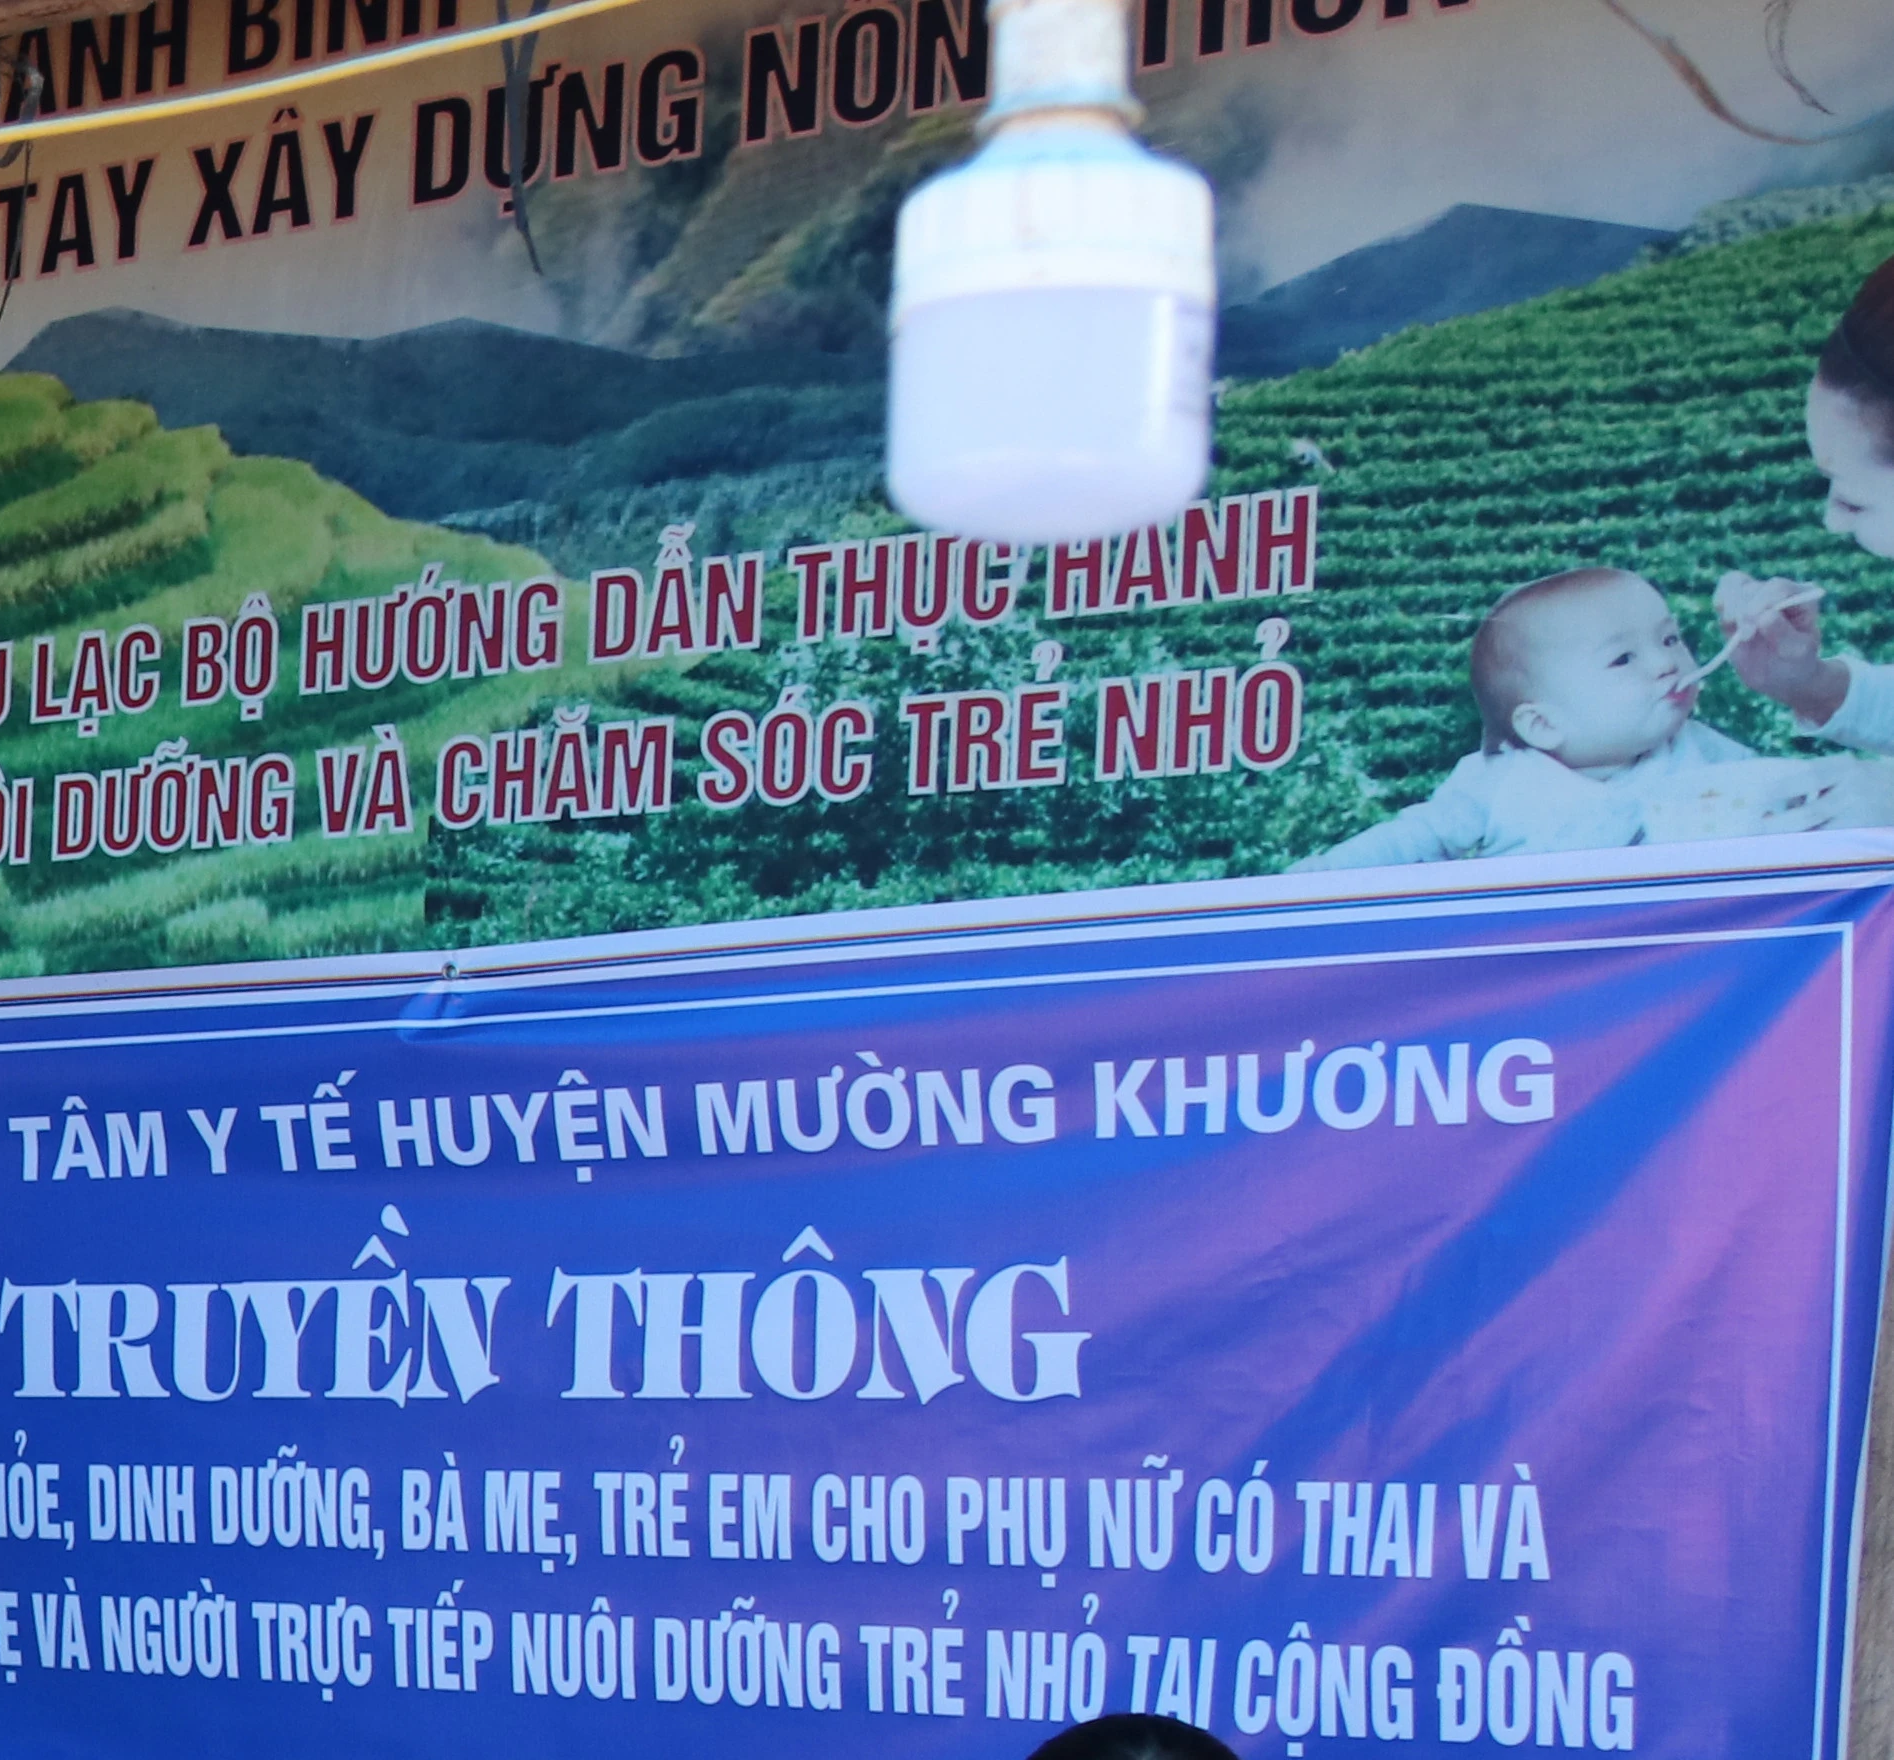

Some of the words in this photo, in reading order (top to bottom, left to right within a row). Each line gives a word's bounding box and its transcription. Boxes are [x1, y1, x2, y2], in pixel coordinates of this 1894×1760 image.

[187, 107, 376, 248] XÂY
[412, 48, 702, 213] DỰNG
[30, 624, 161, 738] LẠC
[181, 591, 280, 722] BỘ
[300, 561, 564, 696] HƯỚNG
[587, 522, 763, 664] DẪN
[787, 531, 1013, 654] THỰC
[51, 735, 293, 863] DƯỠNG
[315, 722, 413, 840] VÀ
[435, 704, 674, 831] CHĂM
[699, 682, 873, 812] SÓC
[901, 639, 1069, 797] TRẺ
[1095, 617, 1302, 782] NHỎ
[9, 1095, 168, 1181] TÂM
[187, 1107, 238, 1175] Y
[260, 1069, 358, 1172] TẾ
[378, 1069, 669, 1184] HUYỆN
[695, 1051, 1057, 1156] MƯỜNG
[1093, 1037, 1557, 1141] KHƯƠNG
[546, 1224, 1092, 1405] THÔNG
[88, 1464, 196, 1545] DINH
[211, 1444, 385, 1560] DƯỠNG,
[401, 1451, 468, 1552] BÀ
[484, 1470, 577, 1573] MẸ,
[594, 1434, 690, 1558] TRẺ
[709, 1473, 793, 1561] EM
[812, 1473, 926, 1565] CHO
[945, 1476, 1067, 1588] PHỤ
[1088, 1454, 1183, 1571] NỮ
[1195, 1460, 1275, 1575] CÓ
[1296, 1480, 1437, 1579] THAI
[1459, 1463, 1551, 1581] VÀ
[32, 1577, 91, 1671] VÀ
[101, 1578, 240, 1680] NGƯỜI
[251, 1596, 373, 1702] TRỰC
[387, 1580, 494, 1692] TIẾP
[511, 1597, 636, 1702] NUÔI
[654, 1596, 842, 1711] DƯỠNG
[859, 1589, 965, 1716] TRẺ
[985, 1592, 1107, 1723] NHỎ
[1233, 1621, 1415, 1759] CỘNG
[1437, 1615, 1635, 1751] ĐỒNG
